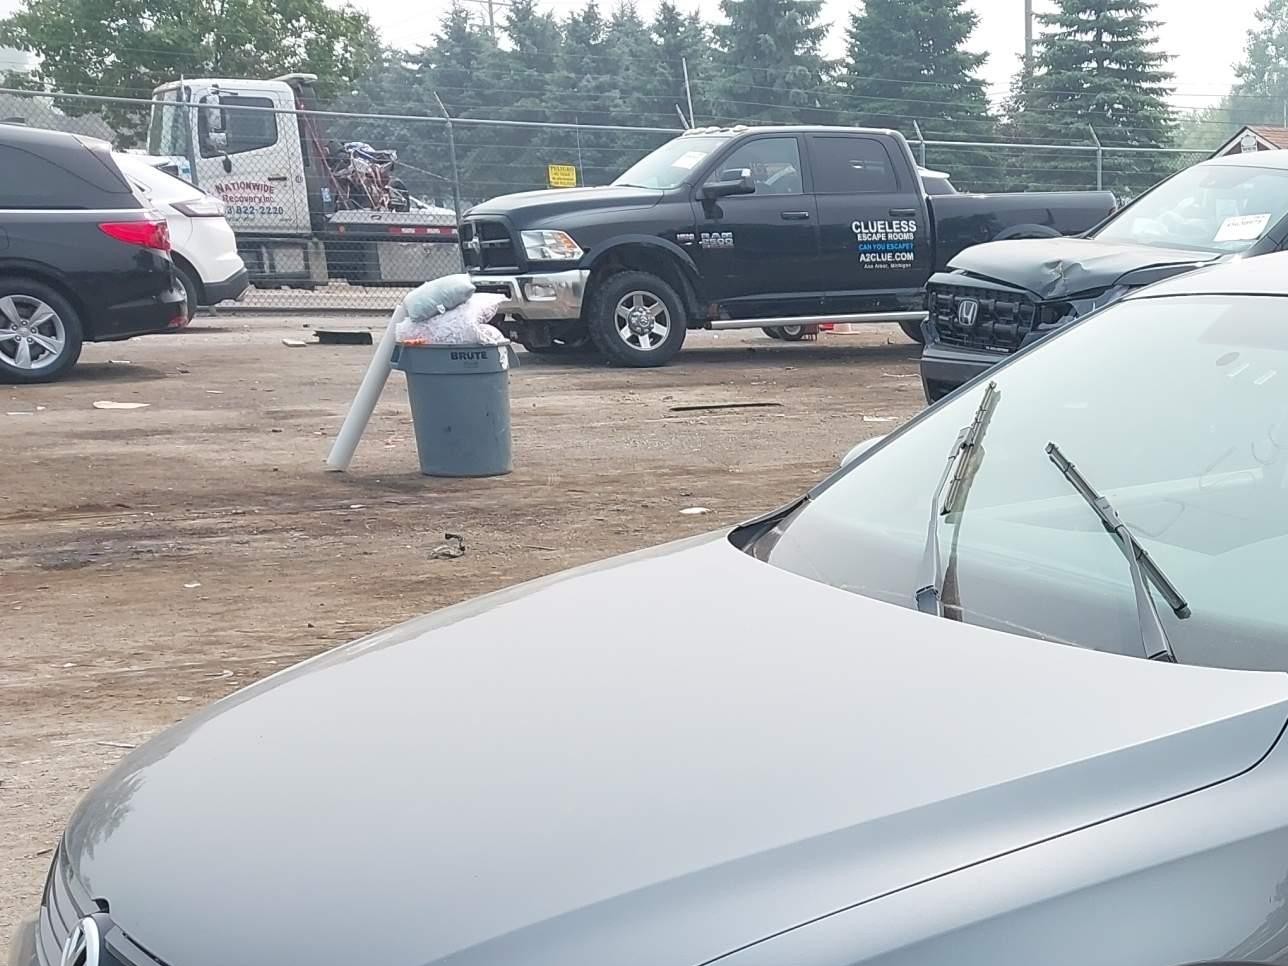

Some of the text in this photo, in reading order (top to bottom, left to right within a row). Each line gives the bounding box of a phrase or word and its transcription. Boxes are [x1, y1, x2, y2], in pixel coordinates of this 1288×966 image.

[215, 181, 274, 194] NATIONWIDE
[852, 220, 917, 233] CLUELESS
[857, 232, 914, 241] ESCAPE ROOMS
[860, 252, 914, 262] A2CLUE.COM
[450, 351, 488, 360] BRUTE
